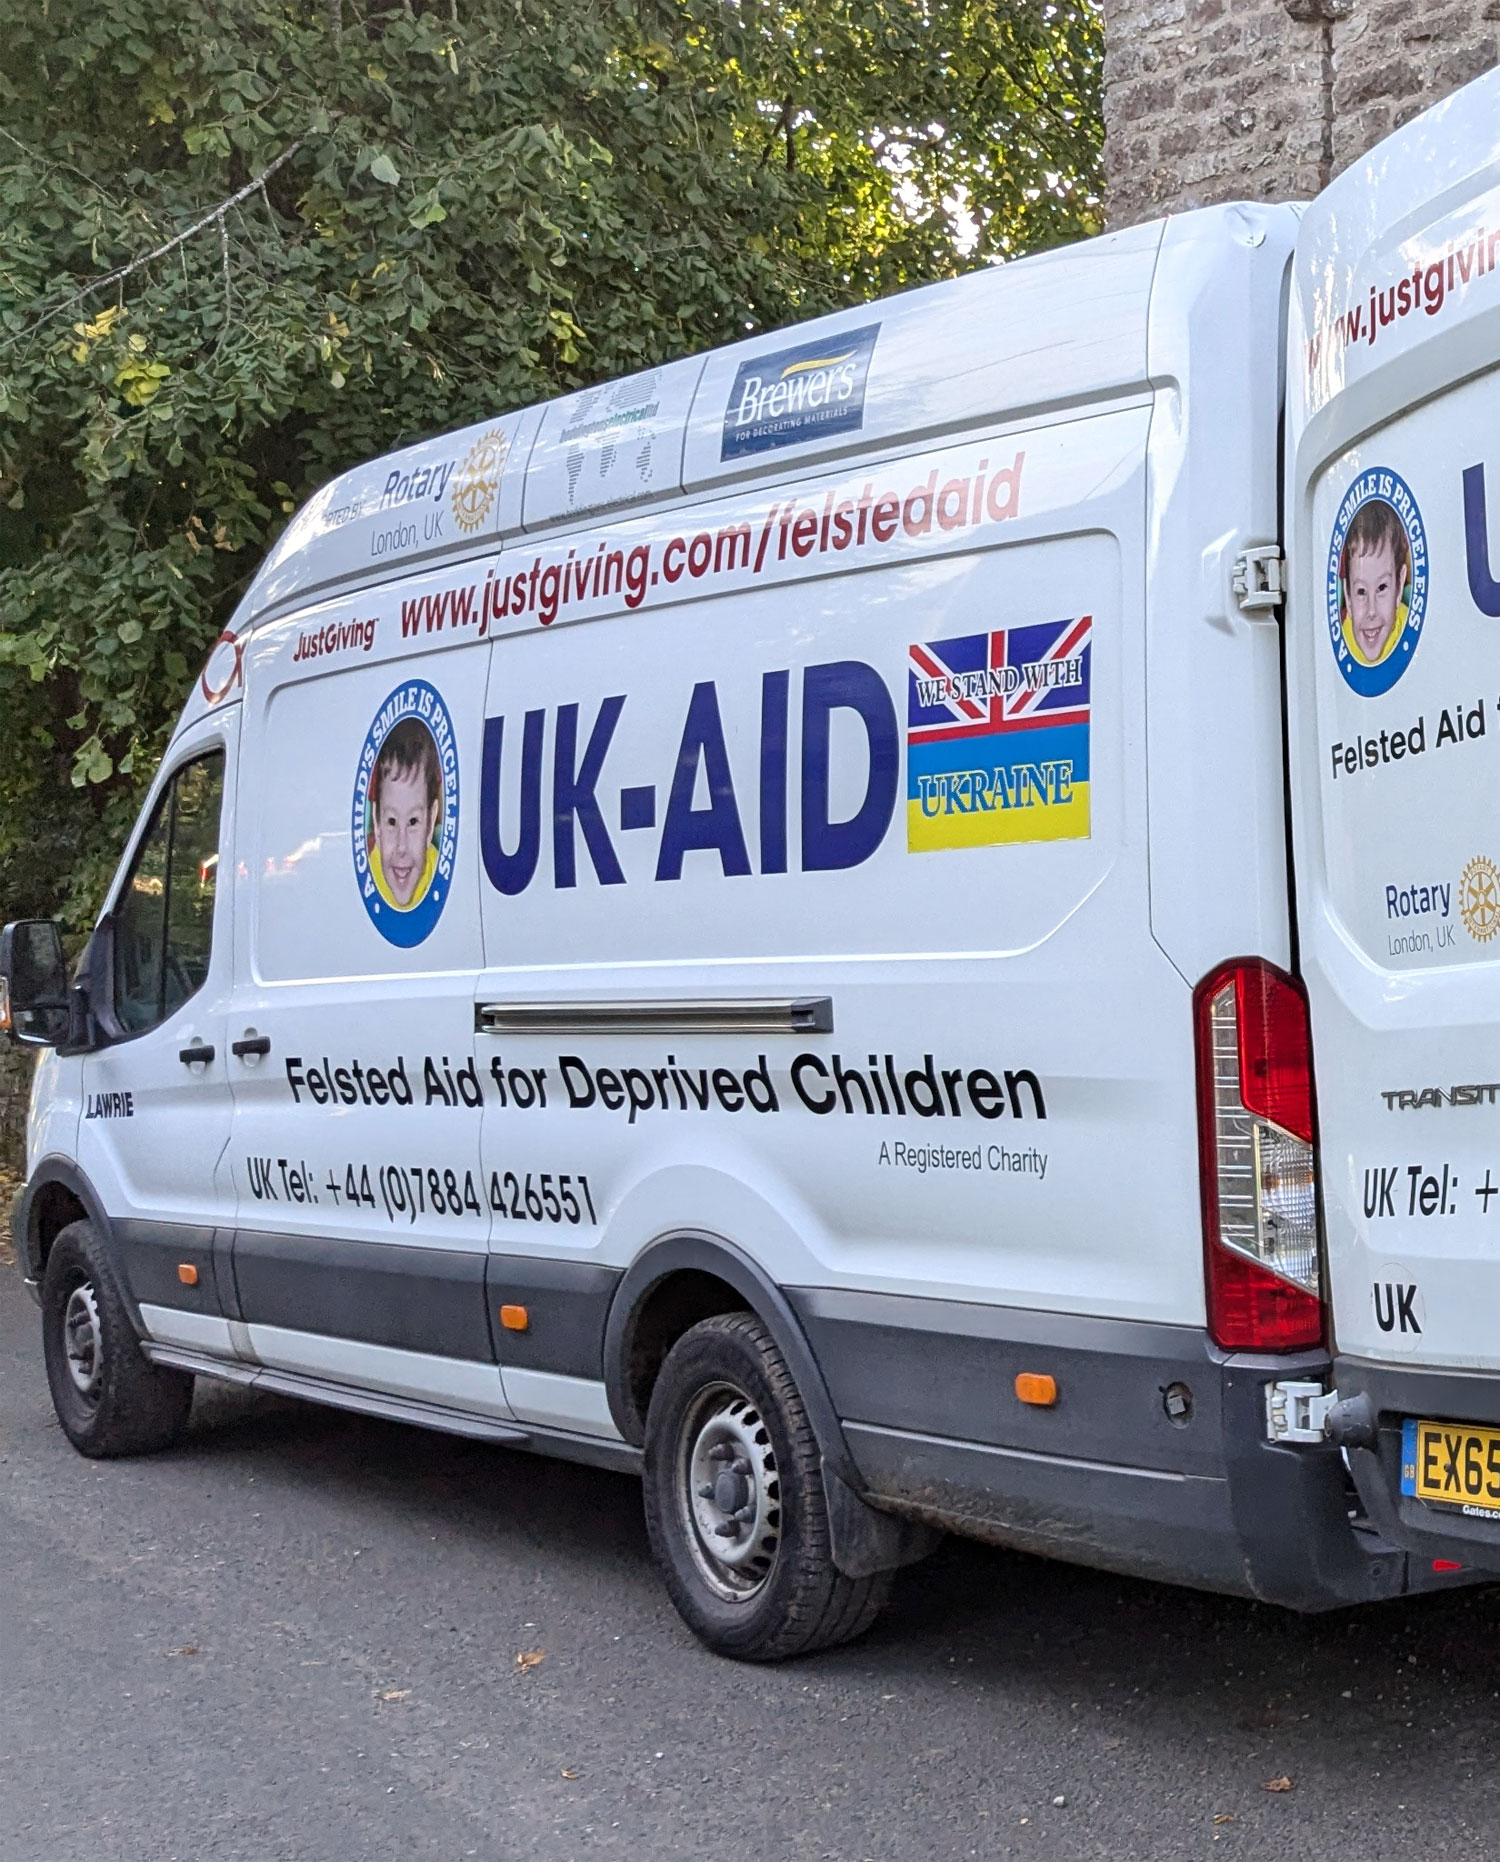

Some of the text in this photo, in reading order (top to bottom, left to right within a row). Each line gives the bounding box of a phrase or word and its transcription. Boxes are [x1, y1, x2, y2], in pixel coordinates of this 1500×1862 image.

[736, 363, 856, 427] Brewers
[736, 408, 848, 442] FOR DECORATING MATERIALS
[380, 461, 455, 509] Rotary
[371, 510, 444, 556] London, UK
[401, 451, 1026, 637] www.justgiving.com/felstedaid
[1339, 474, 1376, 528] SMILE
[1379, 473, 1392, 496] IS
[1393, 482, 1426, 631] PRICELESS
[918, 657, 1083, 706] WE STAND WITH
[1331, 716, 1426, 779] Felsted
[1435, 699, 1486, 748] Aid
[373, 687, 418, 744] SMILE
[417, 689, 434, 718] IS
[432, 703, 457, 881] PRICELESS
[480, 660, 900, 896] UK-AID
[918, 759, 1074, 817] UKRAINE
[1385, 883, 1451, 919] Rotary
[1388, 924, 1456, 956] London, UK
[286, 1053, 1047, 1124] Felsted Aid for Deprived Children
[879, 1141, 1048, 1180] A Registered Charity
[247, 1157, 597, 1226] UK Tel: +44 (0)7884 426551
[1364, 1167, 1398, 1219] UK
[1407, 1163, 1458, 1216] Tel:
[1373, 1282, 1422, 1334] UK
[1404, 1464, 1415, 1479] GB
